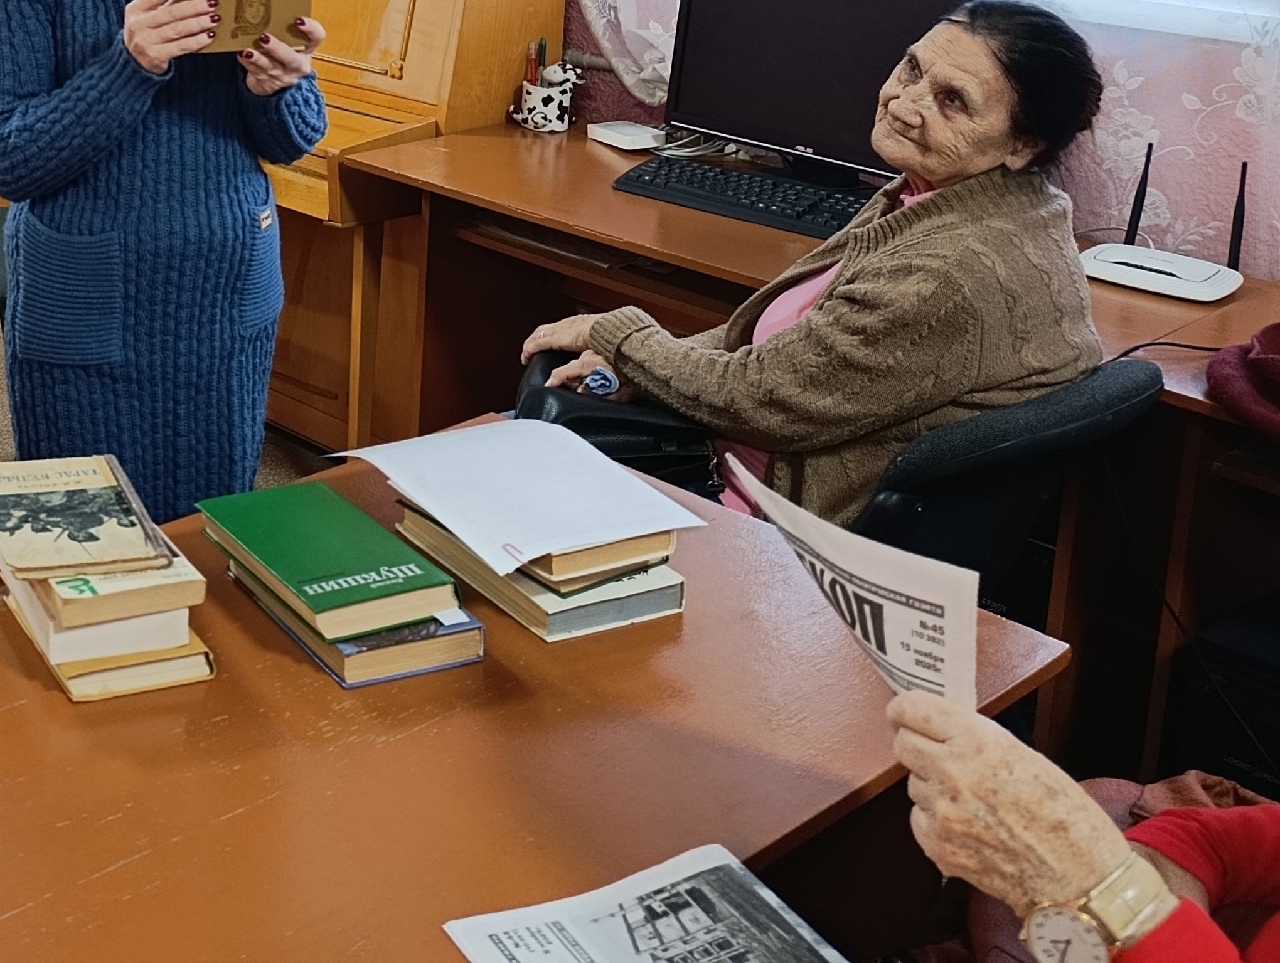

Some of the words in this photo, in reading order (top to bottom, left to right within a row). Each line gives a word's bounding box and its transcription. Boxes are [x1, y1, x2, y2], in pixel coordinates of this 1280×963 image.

[302, 563, 425, 596] Шукшин
[900, 641, 911, 652] 15
[913, 648, 945, 664] ноября
